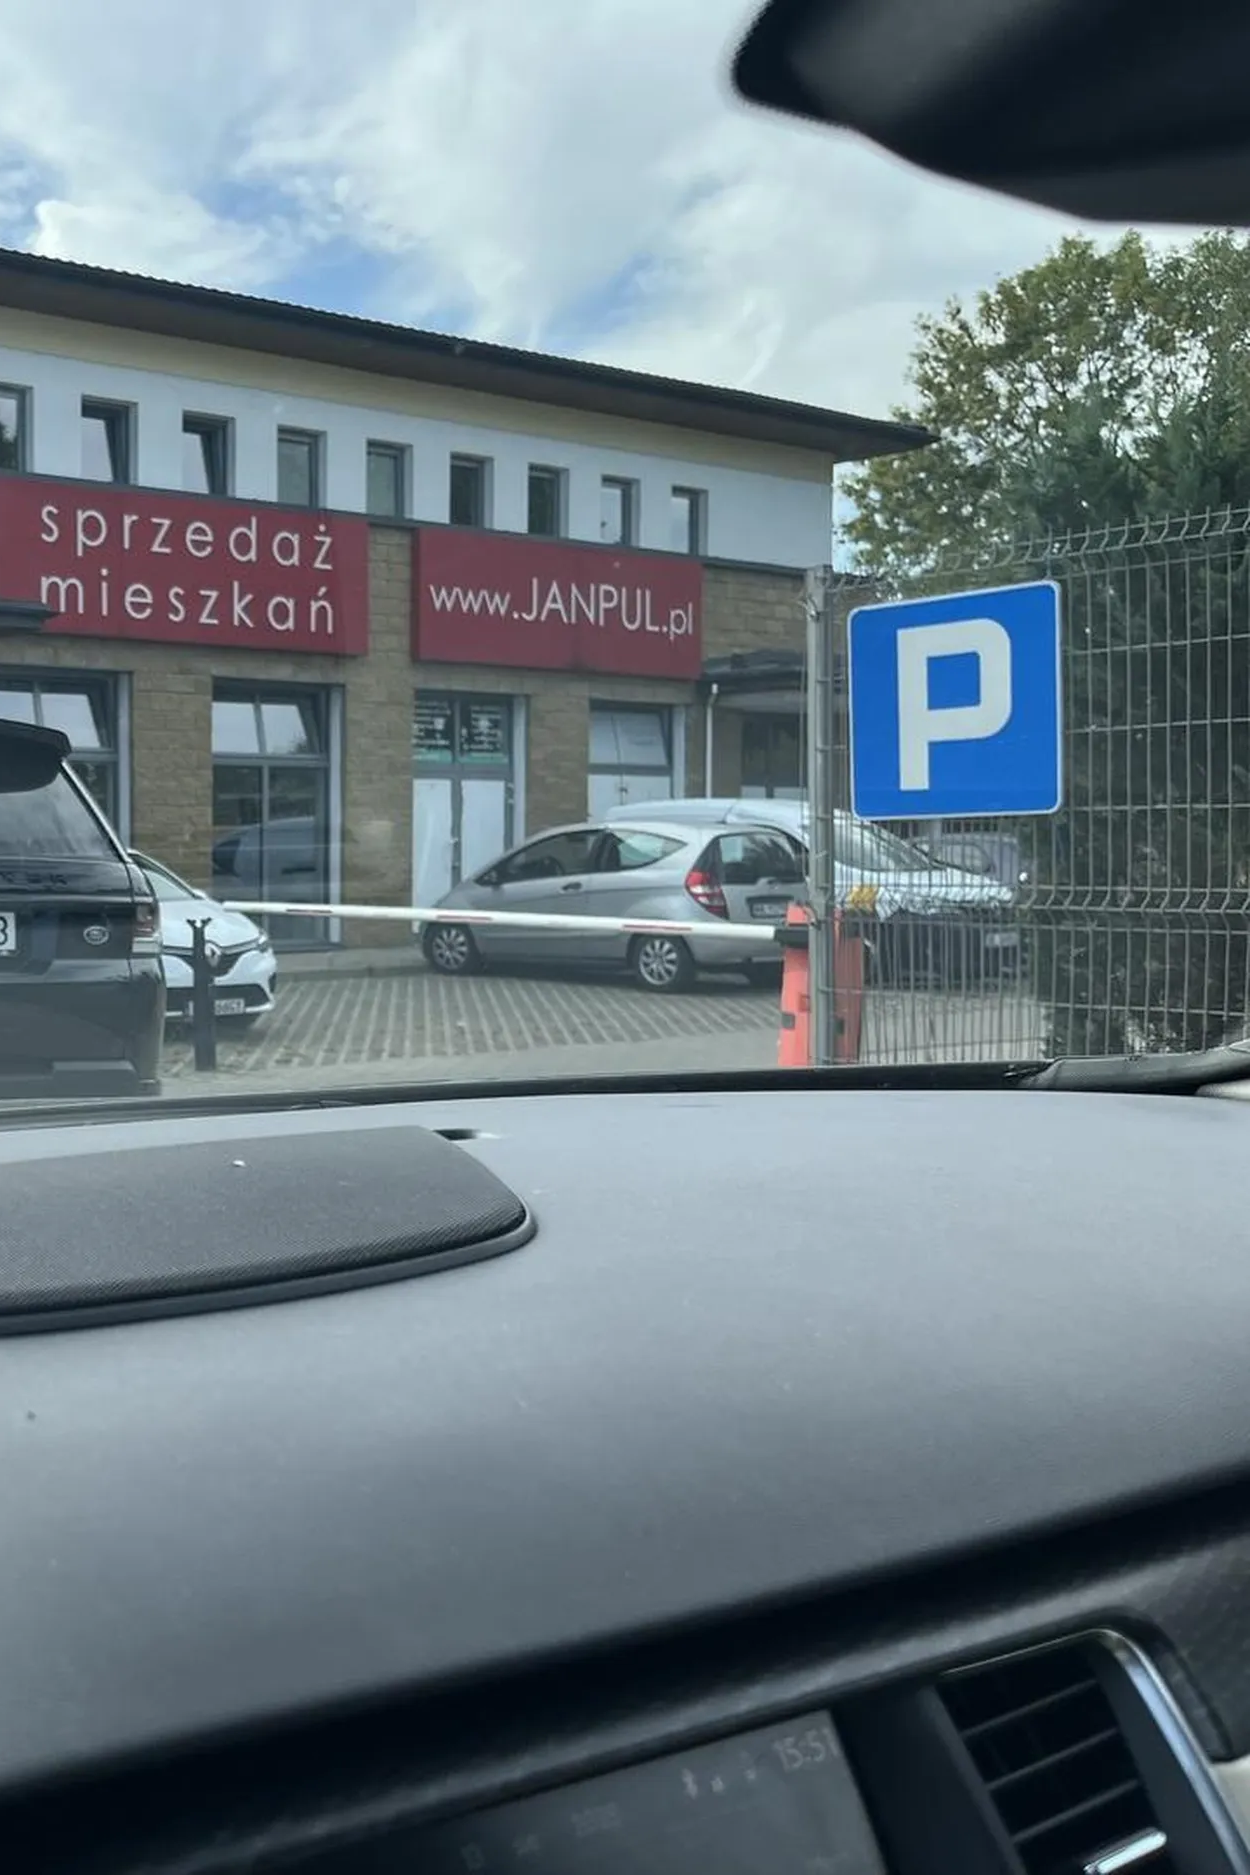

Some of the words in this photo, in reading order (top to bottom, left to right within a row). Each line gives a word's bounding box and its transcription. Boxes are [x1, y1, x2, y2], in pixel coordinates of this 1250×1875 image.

[40, 503, 334, 571] sprzedaż
[40, 567, 334, 635] mieszkań
[429, 577, 694, 643] www.JANPUL.pl
[897, 618, 1013, 791] P
